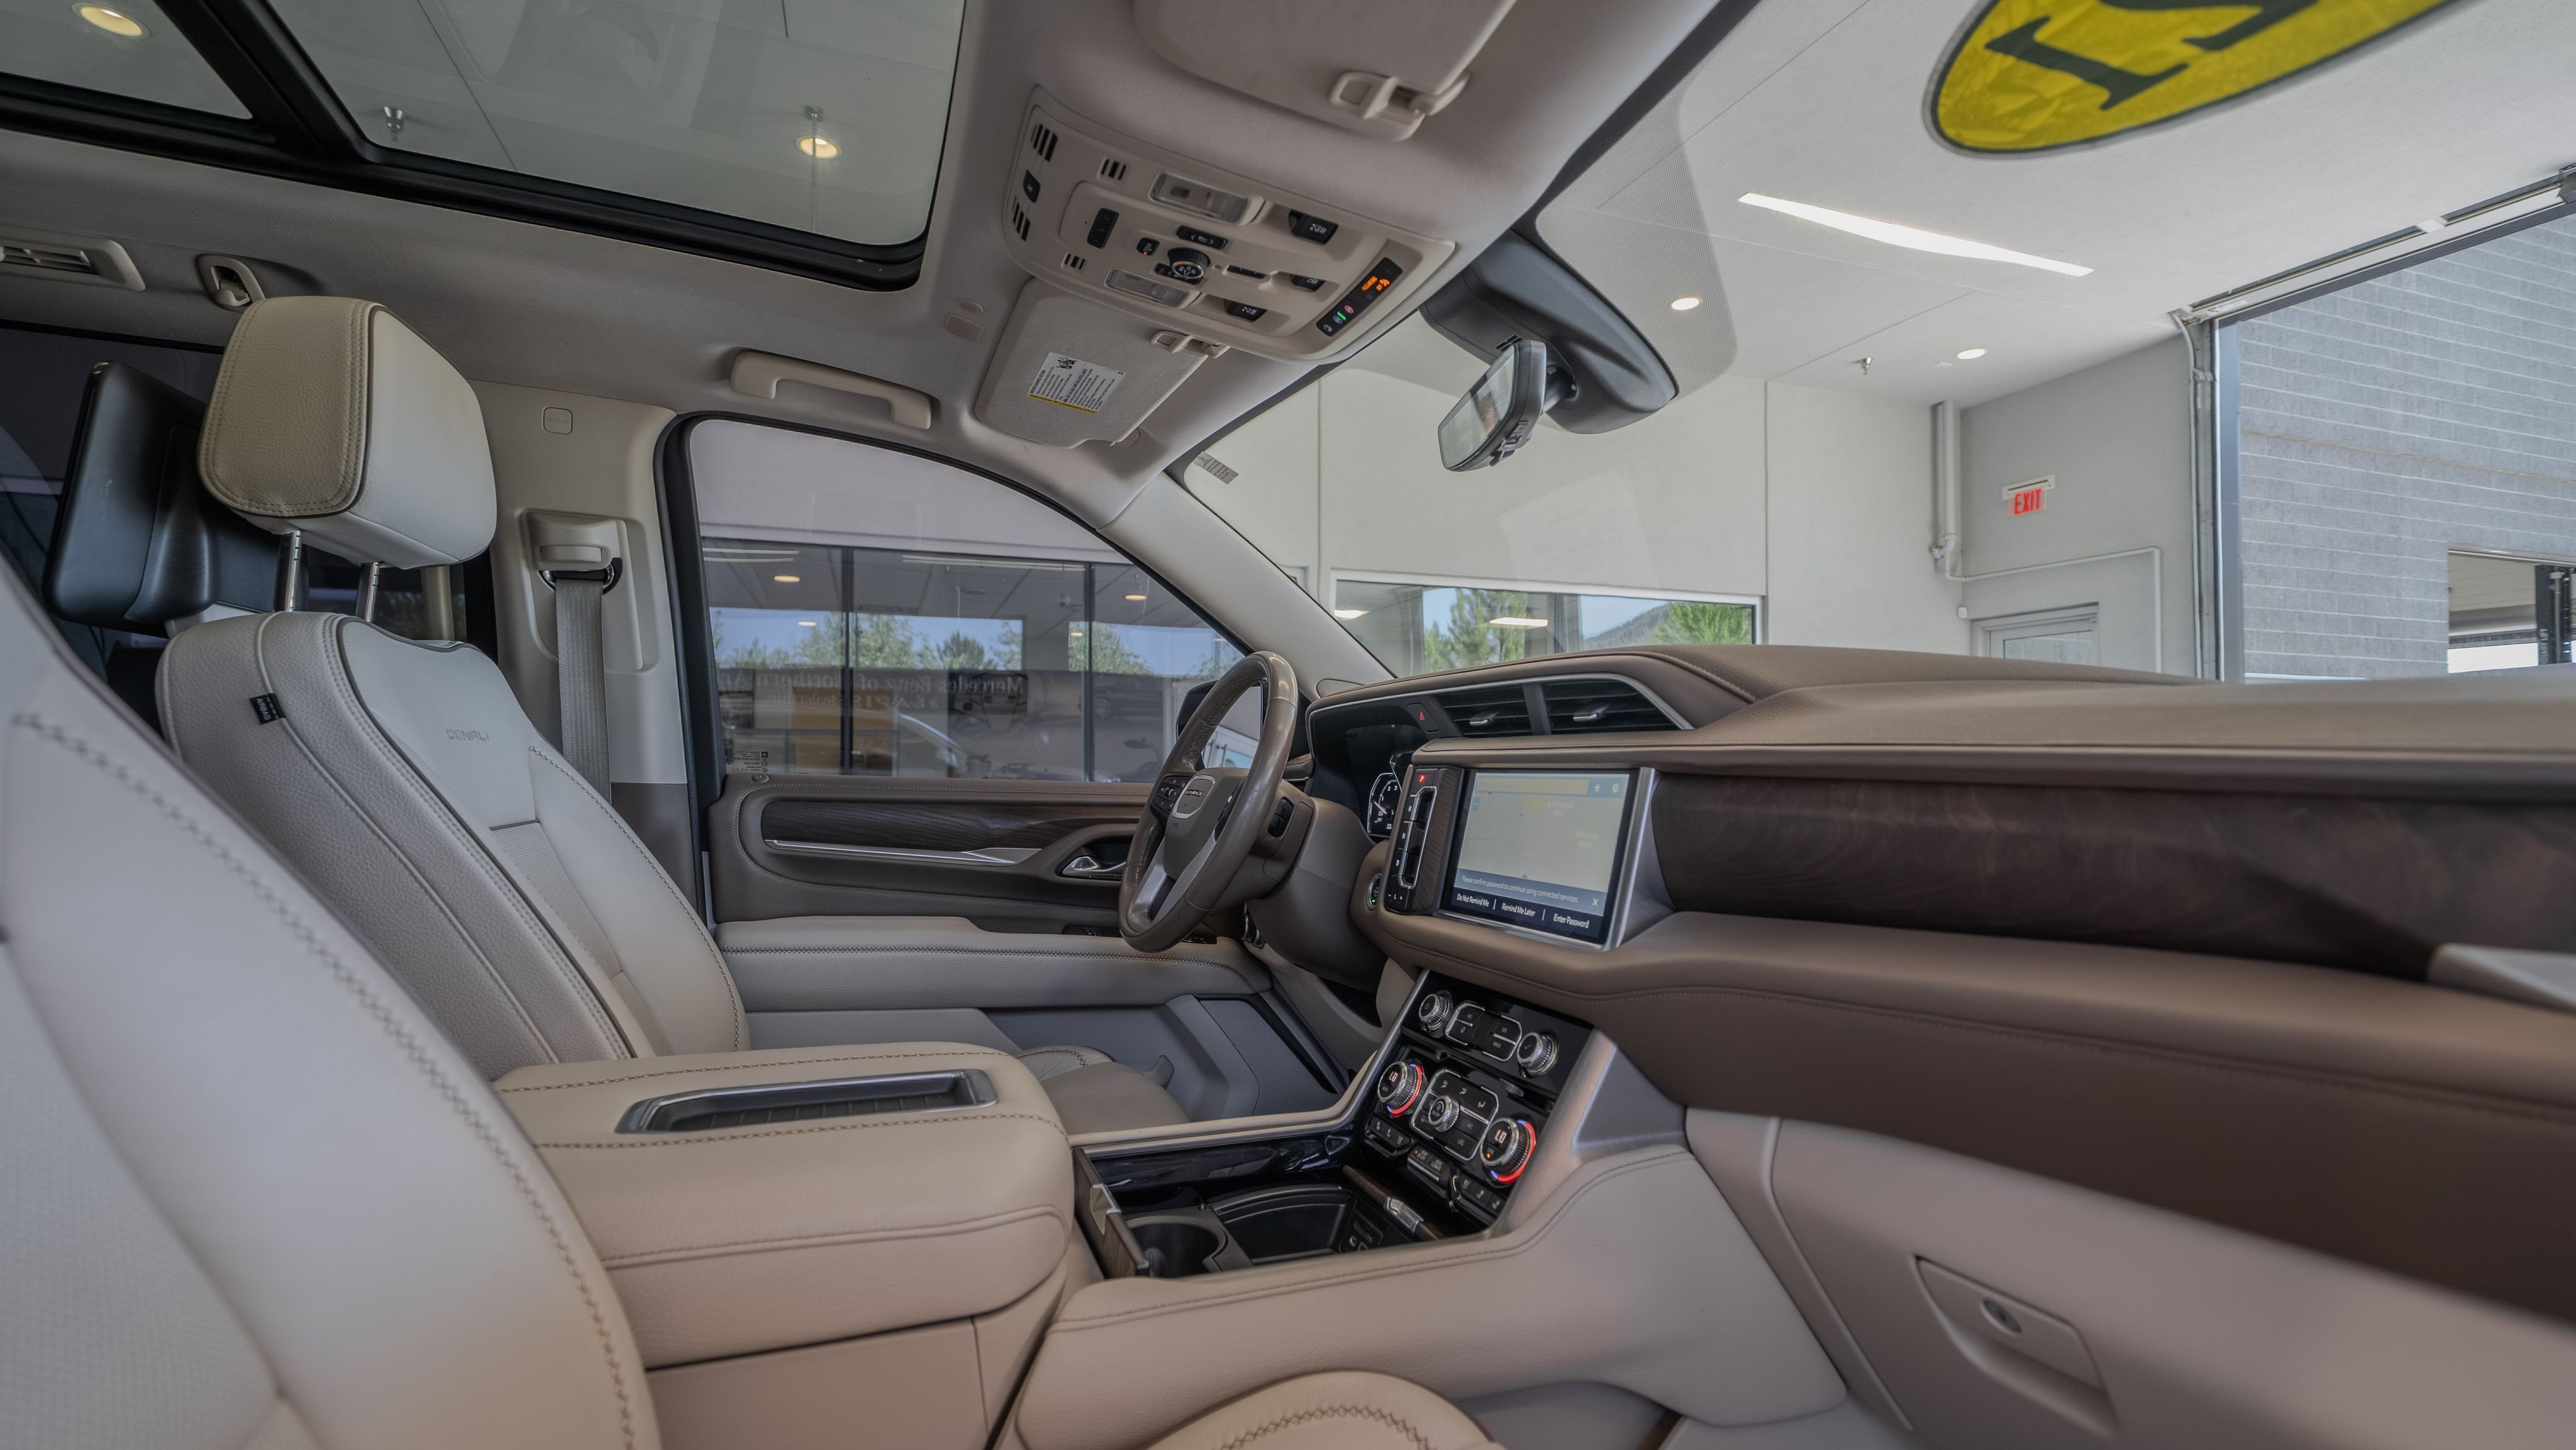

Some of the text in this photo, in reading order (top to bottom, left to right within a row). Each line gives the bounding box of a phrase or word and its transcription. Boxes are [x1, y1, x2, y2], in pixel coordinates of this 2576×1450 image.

[2014, 488, 2042, 515] EXIT
[444, 728, 490, 741] DENALI
[1462, 875, 1473, 883] Please
[1486, 881, 1504, 890] password
[1509, 885, 1526, 893] continue
[1526, 888, 1537, 896] using
[1537, 890, 1560, 899] connected
[1560, 895, 1579, 903] services.
[1469, 896, 1483, 905] Remind
[1483, 899, 1489, 907] Me
[1502, 903, 1535, 917] Remind Me Later
[1553, 913, 1590, 929] Enter Password
[1494, 1129, 1507, 1144] LO
